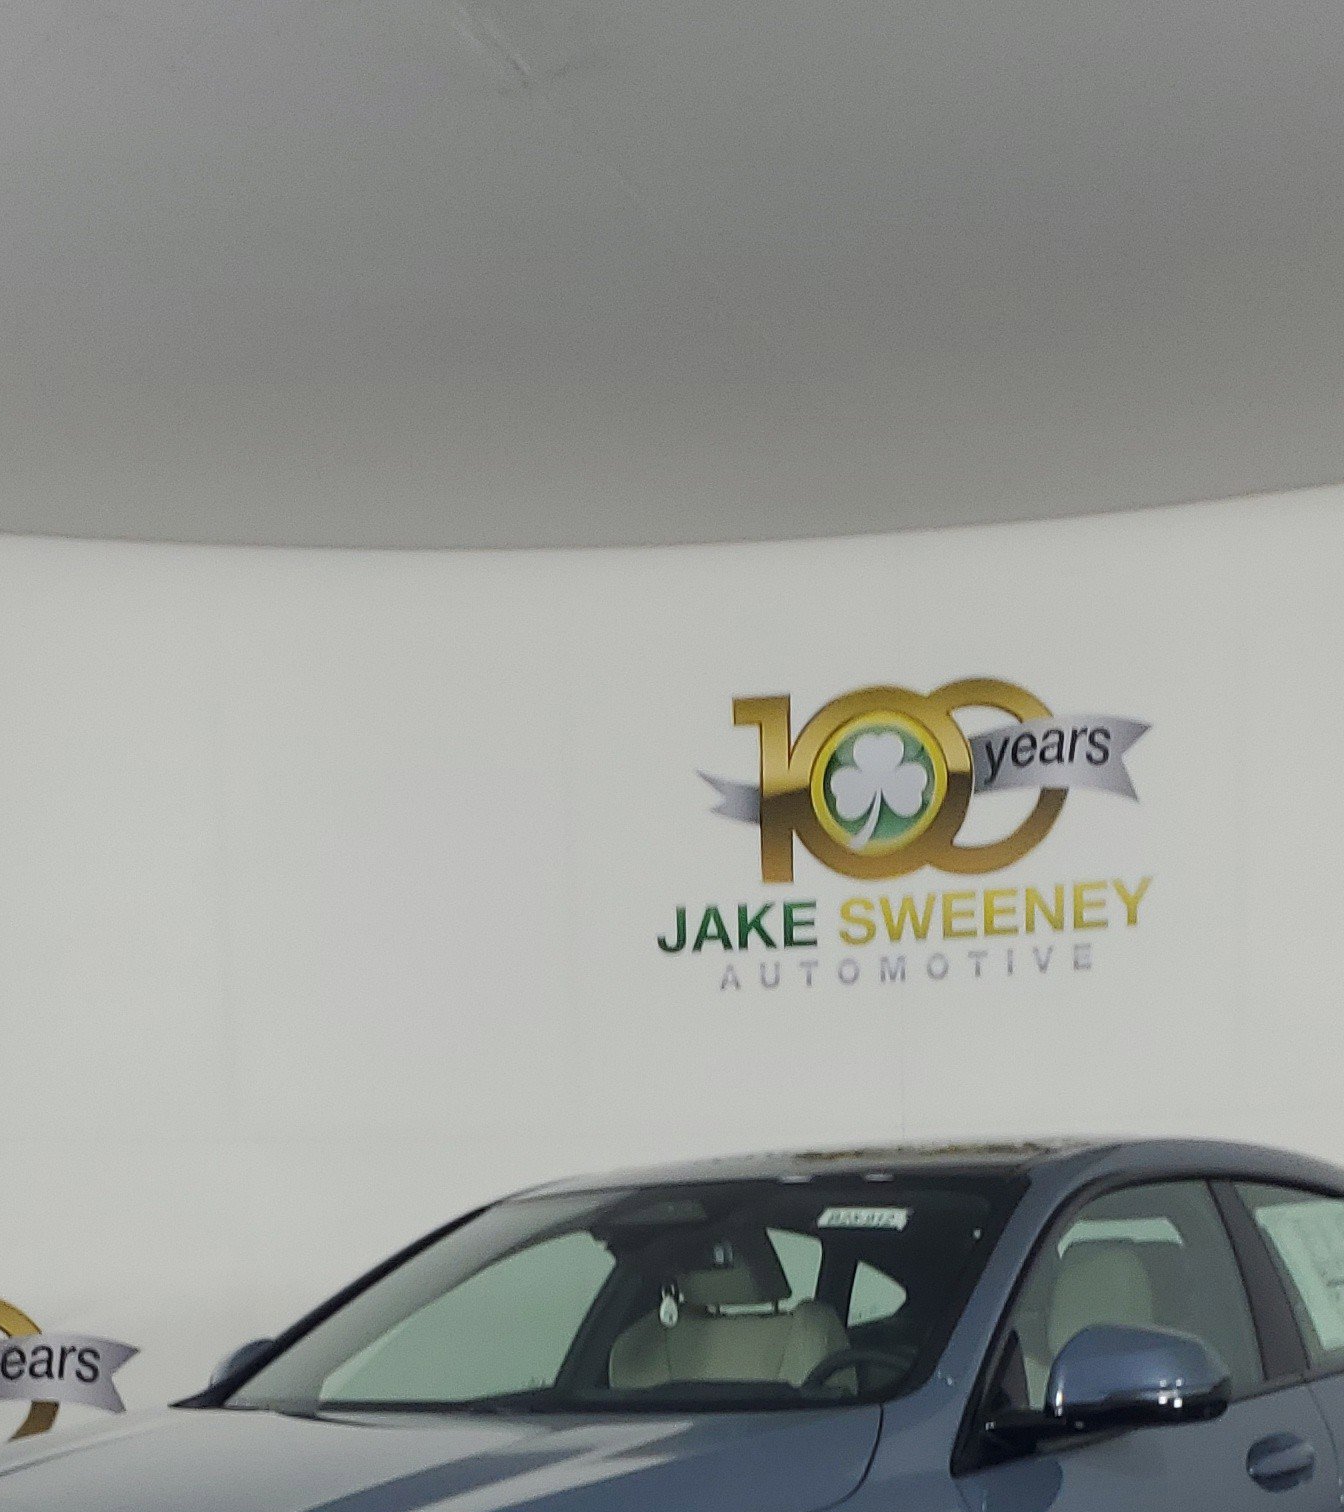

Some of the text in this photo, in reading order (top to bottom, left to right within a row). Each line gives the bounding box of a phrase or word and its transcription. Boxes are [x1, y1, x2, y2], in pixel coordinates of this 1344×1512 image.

[732, 678, 1111, 886] 100 years
[656, 876, 1153, 954] JAKE SWEENEY
[720, 944, 1093, 991] AUTOMOTIVE
